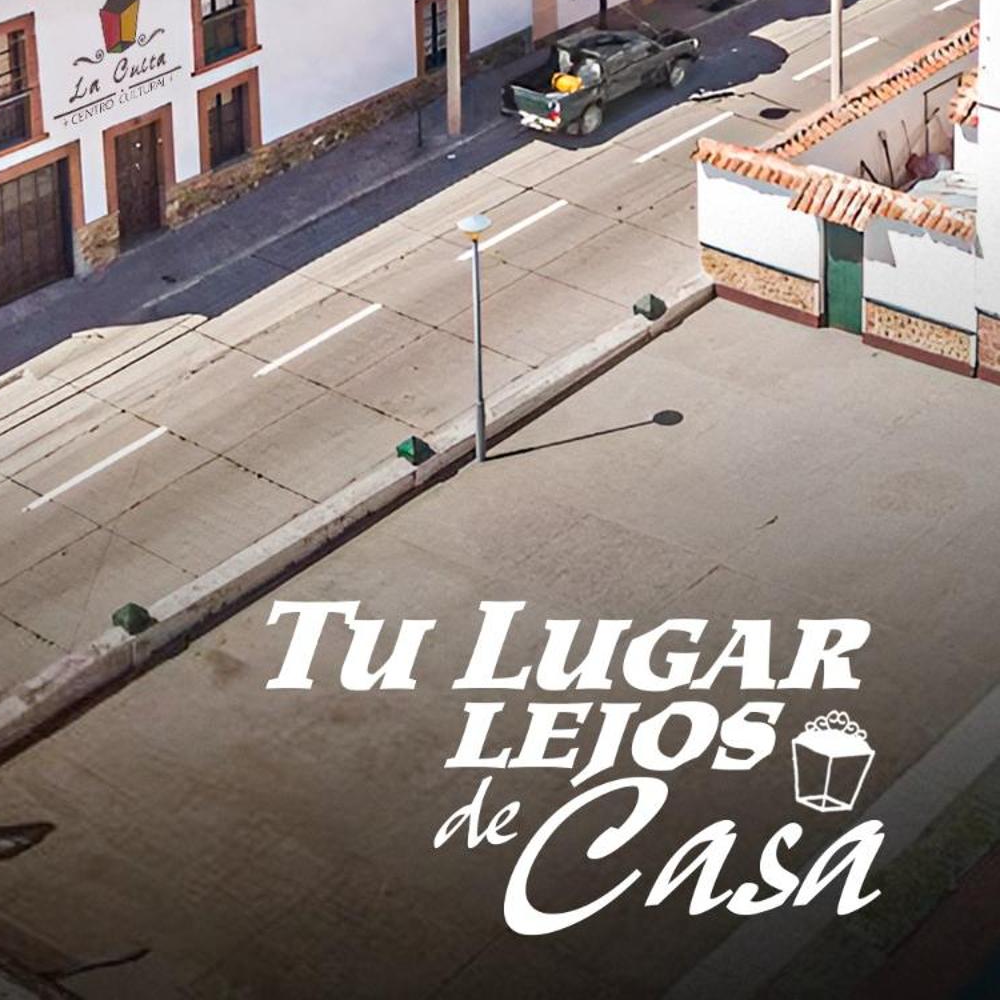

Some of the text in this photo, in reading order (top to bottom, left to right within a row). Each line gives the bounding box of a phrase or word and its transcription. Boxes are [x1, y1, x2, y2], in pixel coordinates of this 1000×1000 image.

[68, 52, 168, 104] La Culta
[70, 77, 166, 126] CENTRO CULTURAL
